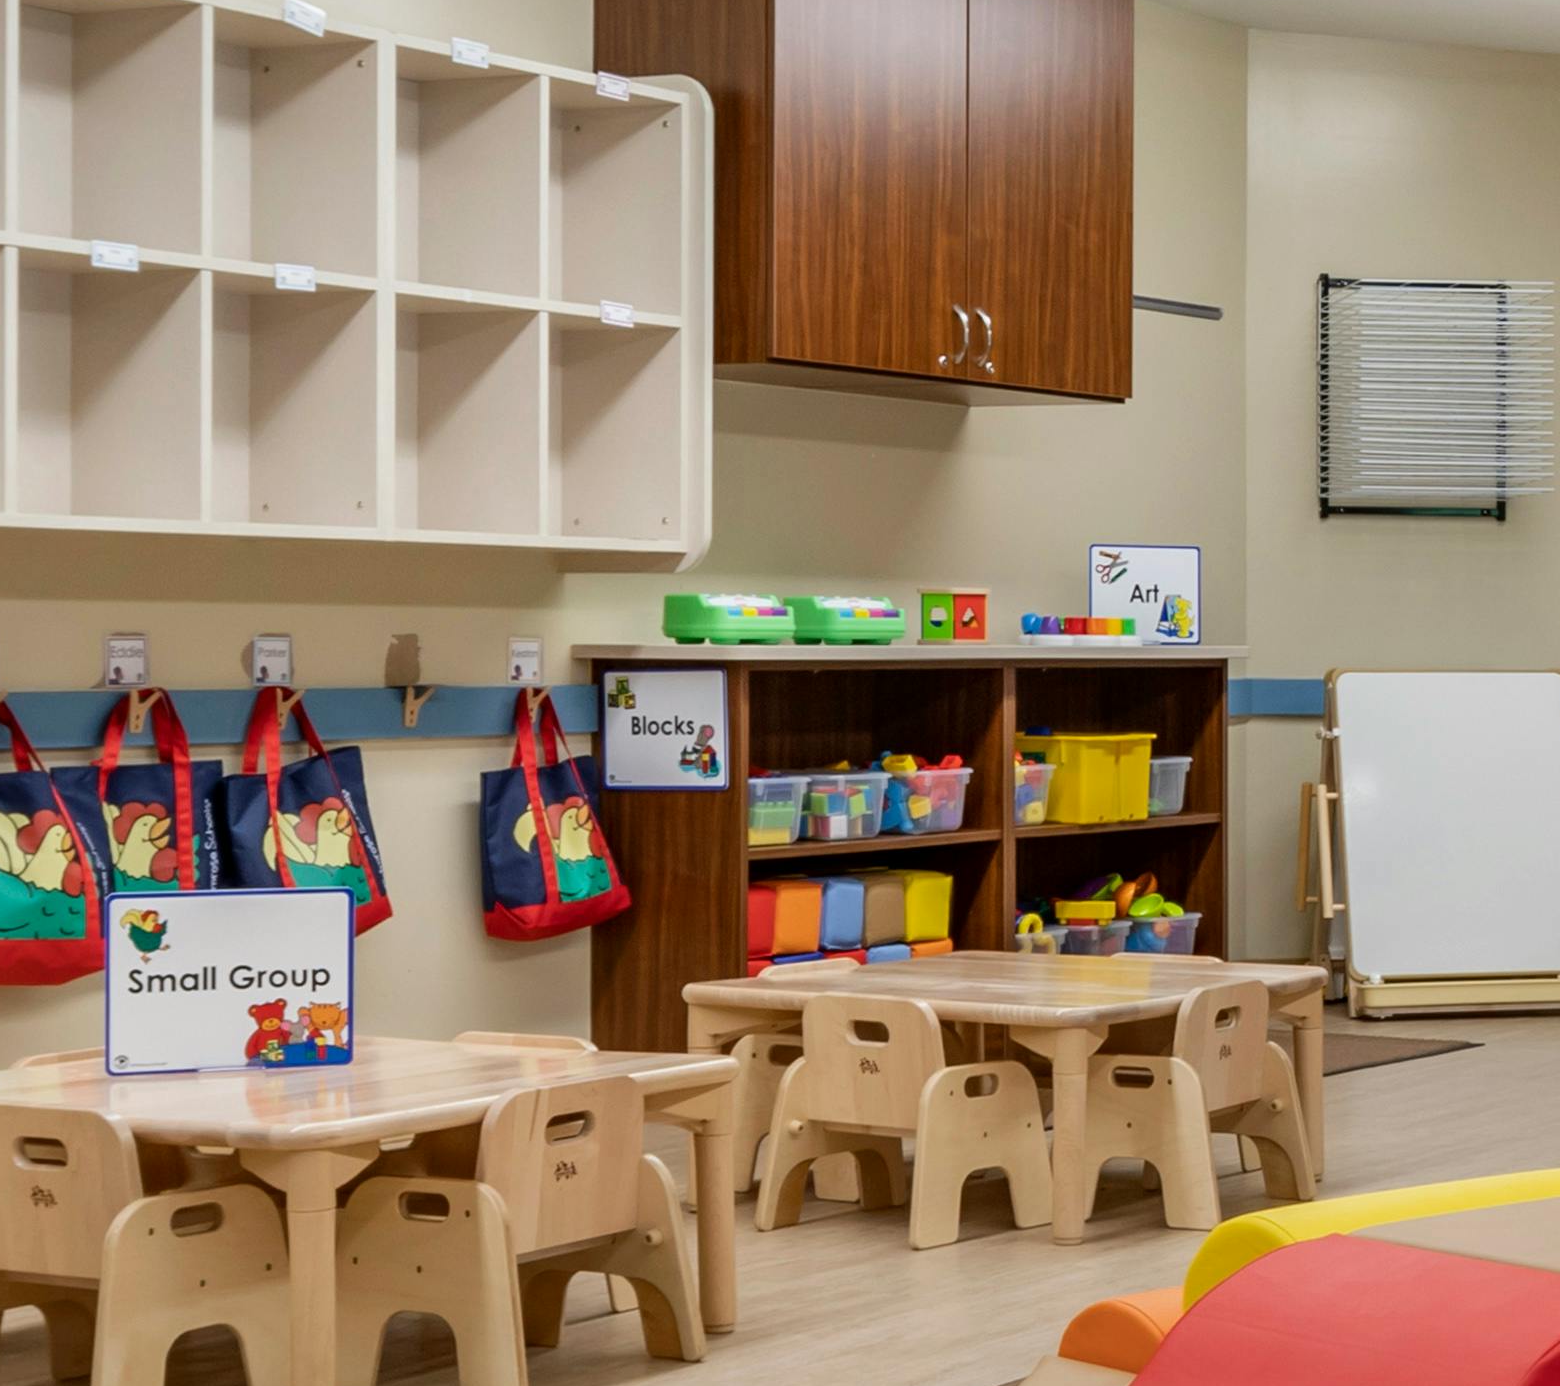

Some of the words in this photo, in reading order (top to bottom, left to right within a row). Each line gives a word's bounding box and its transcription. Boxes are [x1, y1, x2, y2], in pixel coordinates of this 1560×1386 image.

[1129, 583, 1159, 604] Art
[111, 645, 144, 659] Eddie
[631, 715, 695, 736] Blocks
[127, 966, 217, 994] Small
[229, 965, 332, 993] Group
